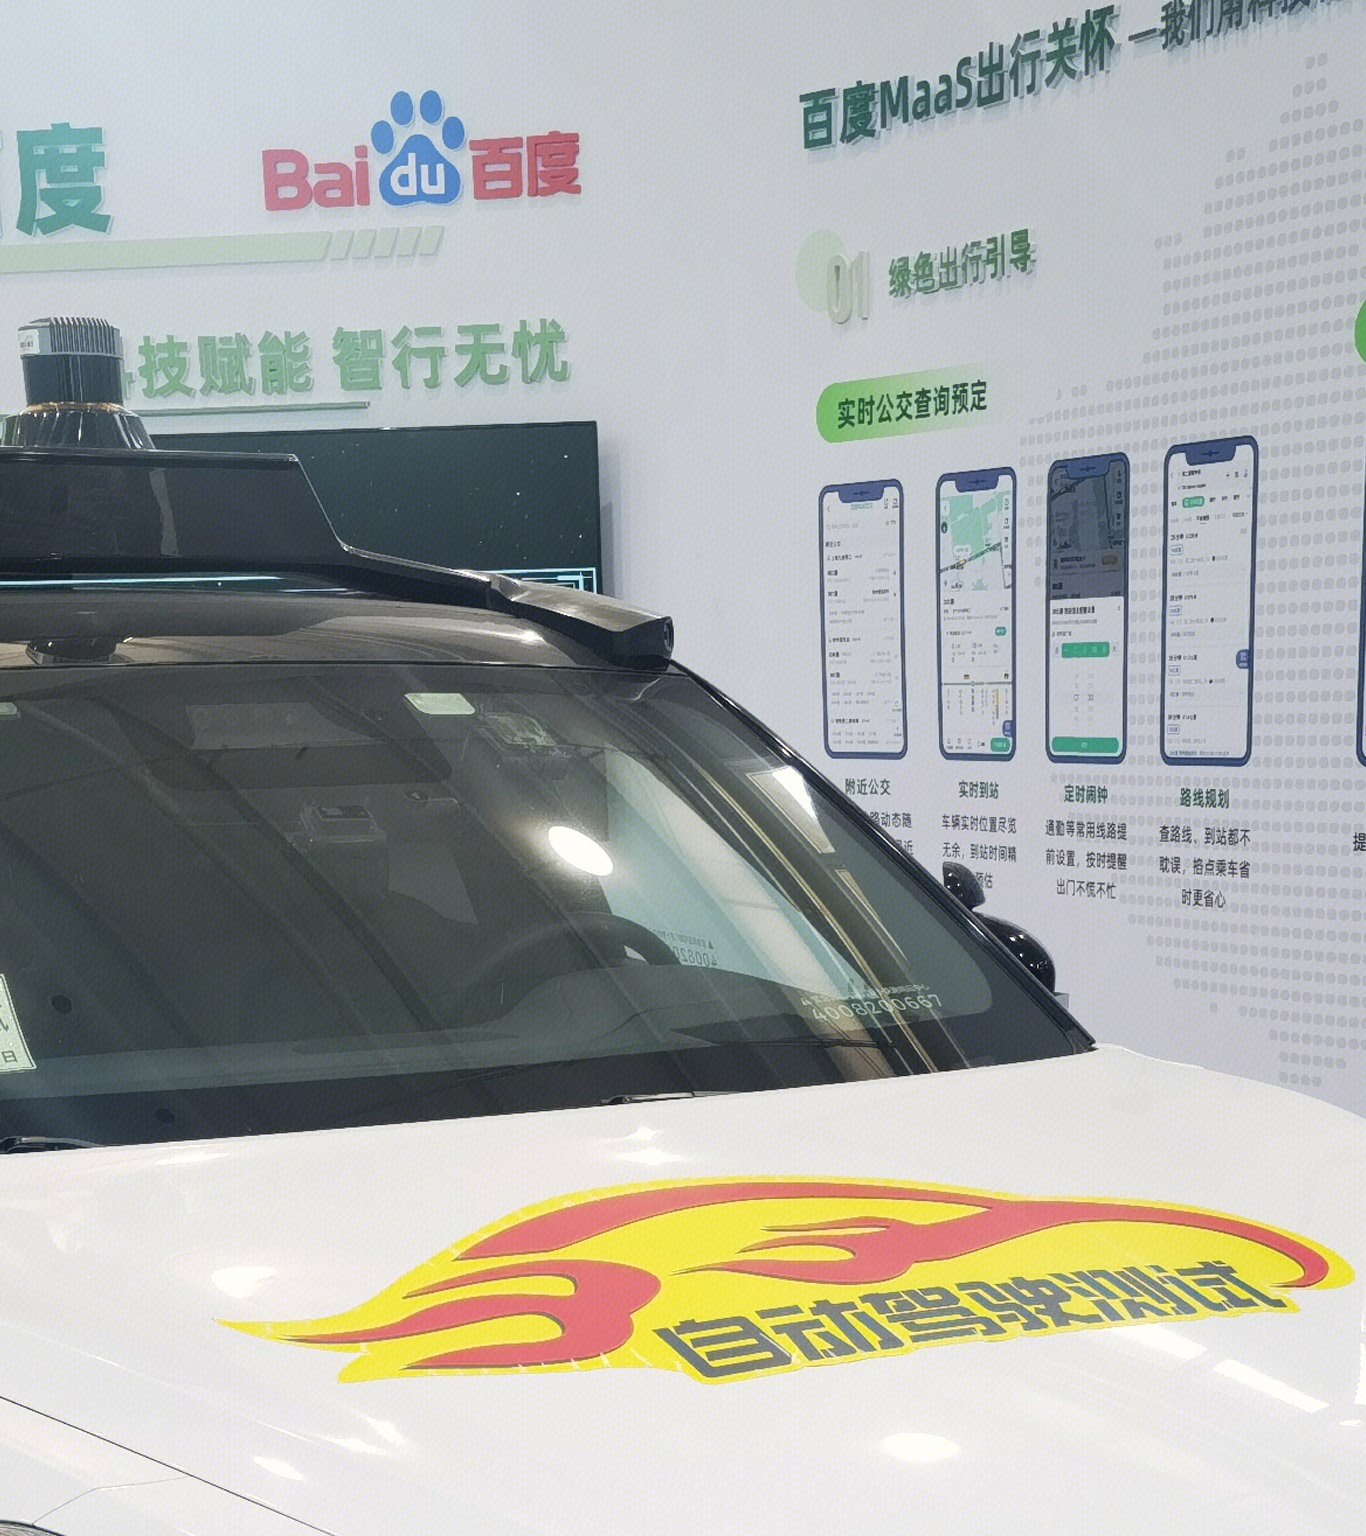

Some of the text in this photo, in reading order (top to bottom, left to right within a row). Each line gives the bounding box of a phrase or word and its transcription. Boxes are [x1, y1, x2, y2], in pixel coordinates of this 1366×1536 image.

[799, 5, 1117, 150] 百度MaaS出行关怀
[469, 131, 582, 200] 百度
[826, 228, 1035, 325] 01 绿色出行引导
[122, 318, 572, 400] 技赋能 智行无忧
[837, 379, 988, 430] 实时公交查询预定
[845, 778, 891, 796] 附近公交
[958, 781, 999, 799] 实时到站
[1063, 784, 1108, 804] 定时闹钟
[1179, 787, 1230, 810] 路线规划
[941, 813, 1017, 835] 车辆实时位置尽览
[1045, 818, 1128, 842] 通勤等常用线路提
[1158, 824, 1252, 848] 查路线、到站都不
[1056, 877, 1117, 900] 出门不慌不忙
[1181, 887, 1227, 909] 时更省心
[653, 1260, 1284, 1378] 自动驾驶测试
